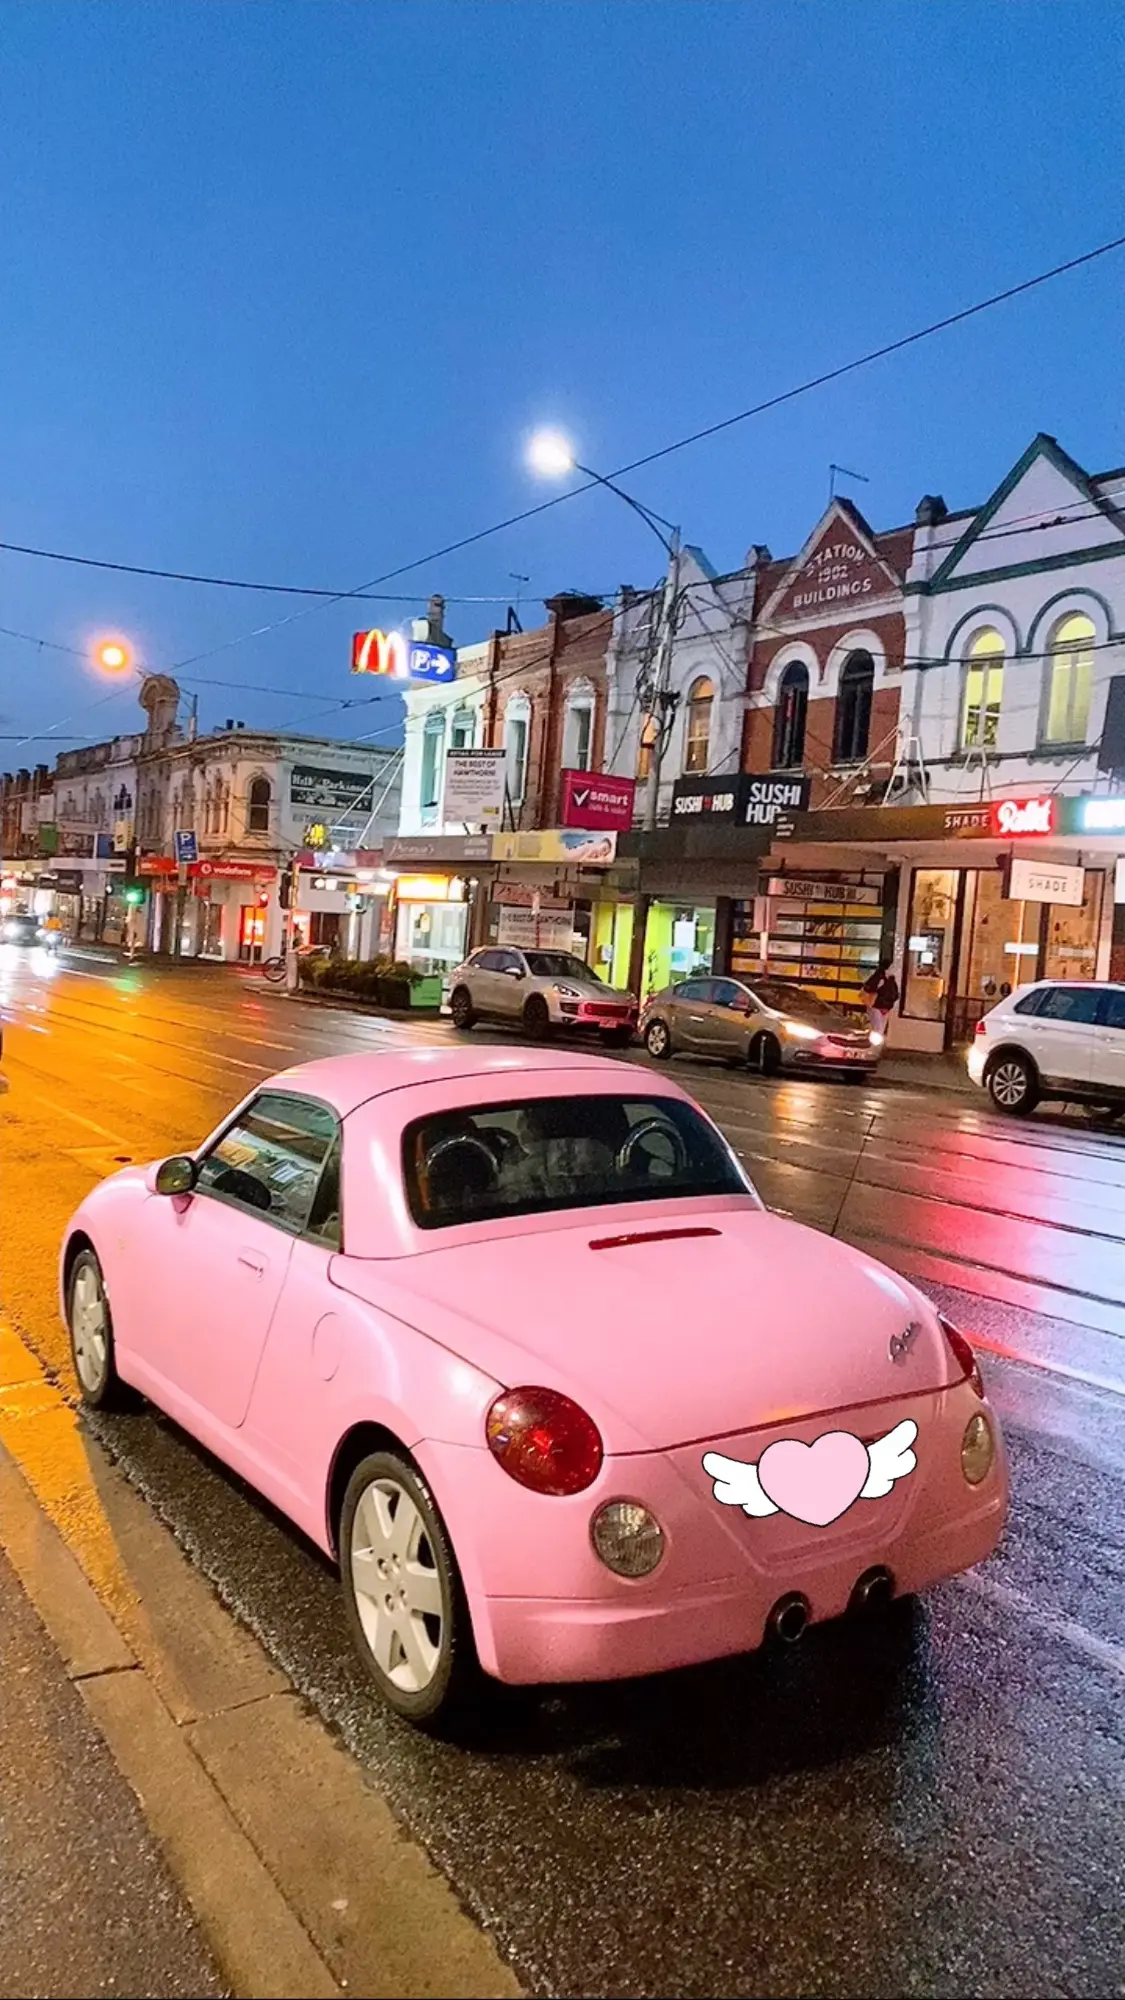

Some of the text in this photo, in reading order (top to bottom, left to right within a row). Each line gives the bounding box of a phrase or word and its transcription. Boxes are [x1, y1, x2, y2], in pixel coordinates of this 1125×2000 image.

[806, 543, 865, 577] STATION
[793, 578, 872, 608] BUILDINGS
[454, 760, 496, 768] THE BEST OF
[589, 791, 629, 806] smart
[749, 782, 802, 806] SUSHI
[674, 793, 734, 814] SUSHI HUB
[944, 814, 990, 829] SHADE
[180, 832, 192, 845] P
[213, 864, 252, 876] vodafone
[783, 880, 814, 896] SUSHI
[1028, 878, 1068, 893] SHADE
